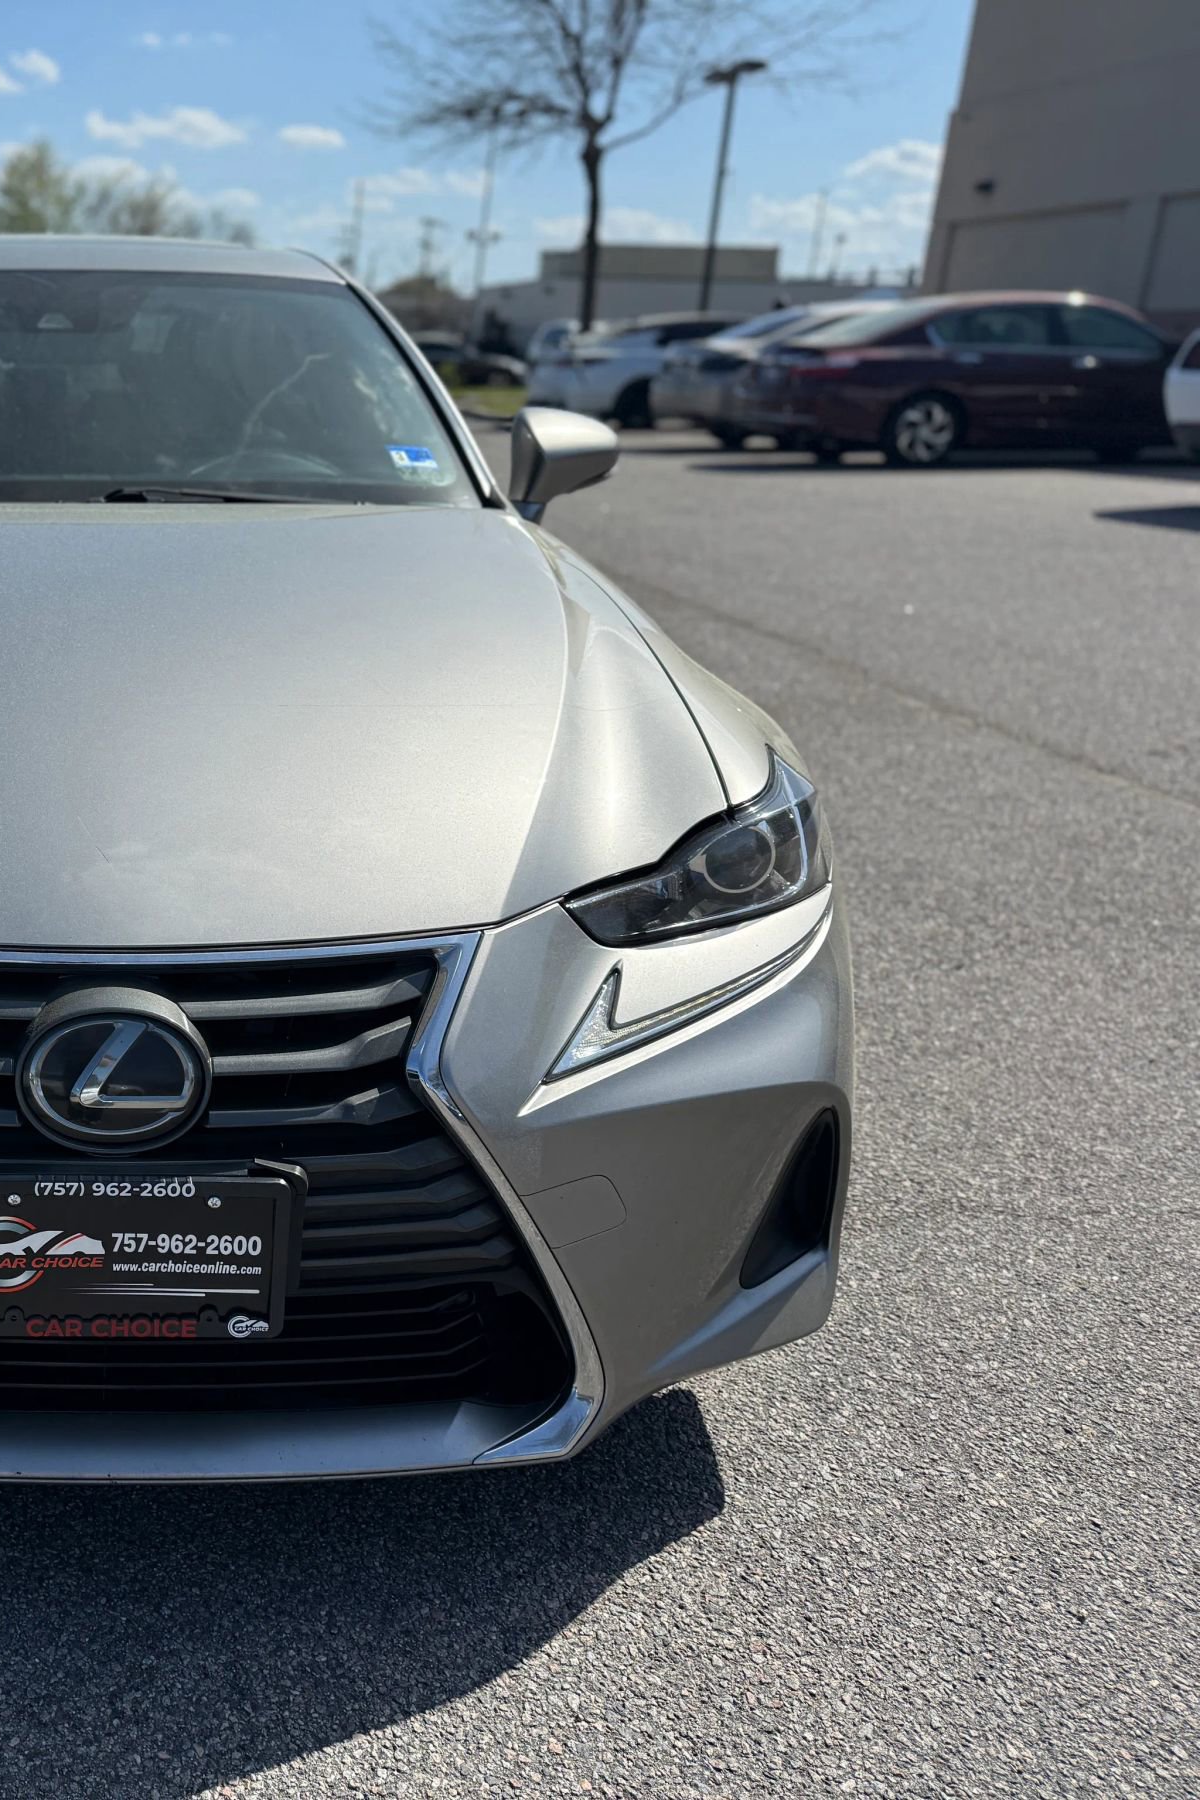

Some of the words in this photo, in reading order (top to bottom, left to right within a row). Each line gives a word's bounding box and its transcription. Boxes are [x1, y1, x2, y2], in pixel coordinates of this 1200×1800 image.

[34, 1182, 85, 1197] (757)
[92, 1182, 196, 1198] 962-2600
[111, 1232, 262, 1256] 757-962-2600
[31, 1257, 104, 1268] CHOICE
[112, 1260, 262, 1275] www.carchoiceonline.com
[25, 1318, 83, 1338] CAR
[91, 1318, 198, 1338] CHOICE
